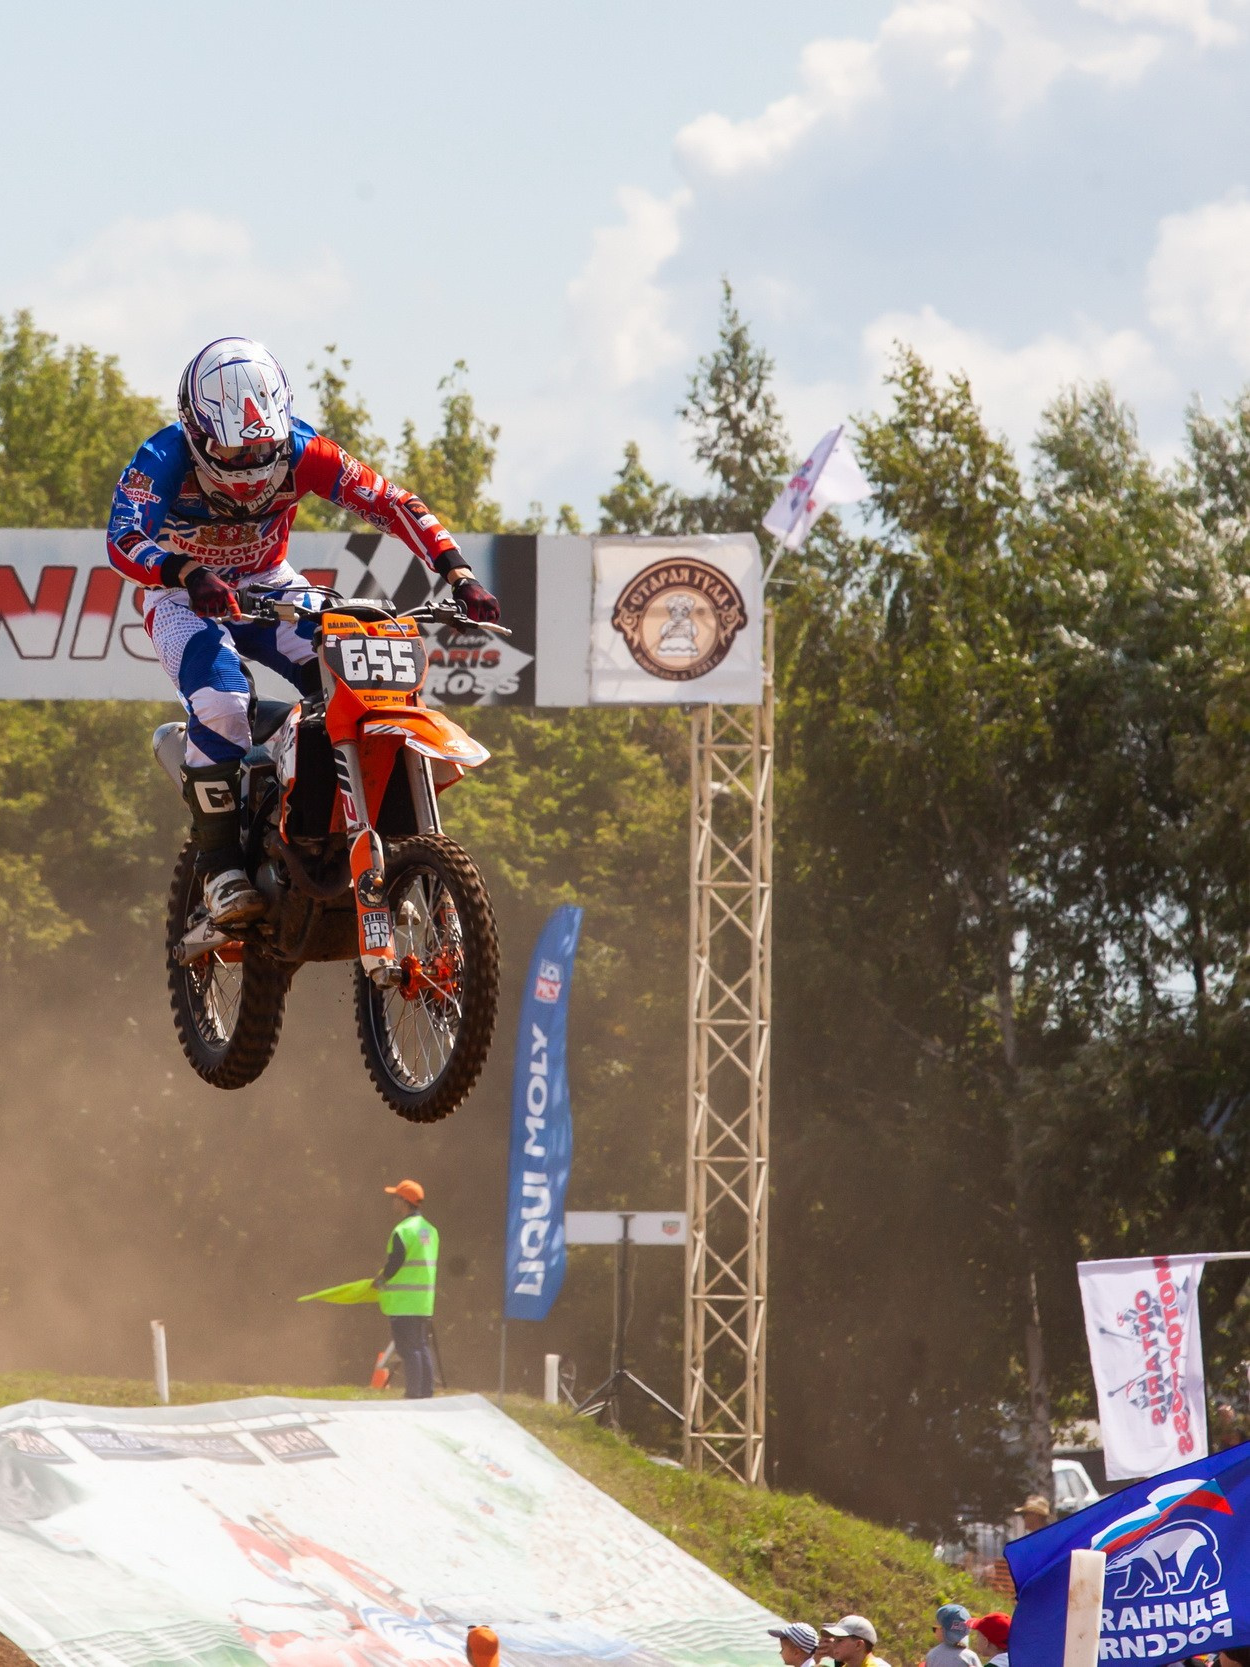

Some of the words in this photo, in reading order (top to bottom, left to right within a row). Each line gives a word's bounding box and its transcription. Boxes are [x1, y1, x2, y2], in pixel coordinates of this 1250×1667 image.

[239, 419, 275, 440] 6D
[171, 529, 278, 558] SVERDLOVSKY
[193, 553, 256, 566] REGION
[340, 638, 417, 684] 655
[429, 648, 501, 669] ARIS
[363, 913, 388, 923] RIDE
[364, 922, 389, 935] 100
[365, 934, 391, 950] MX
[524, 1023, 549, 1158] MOLY
[514, 1170, 551, 1297] LIQUI
